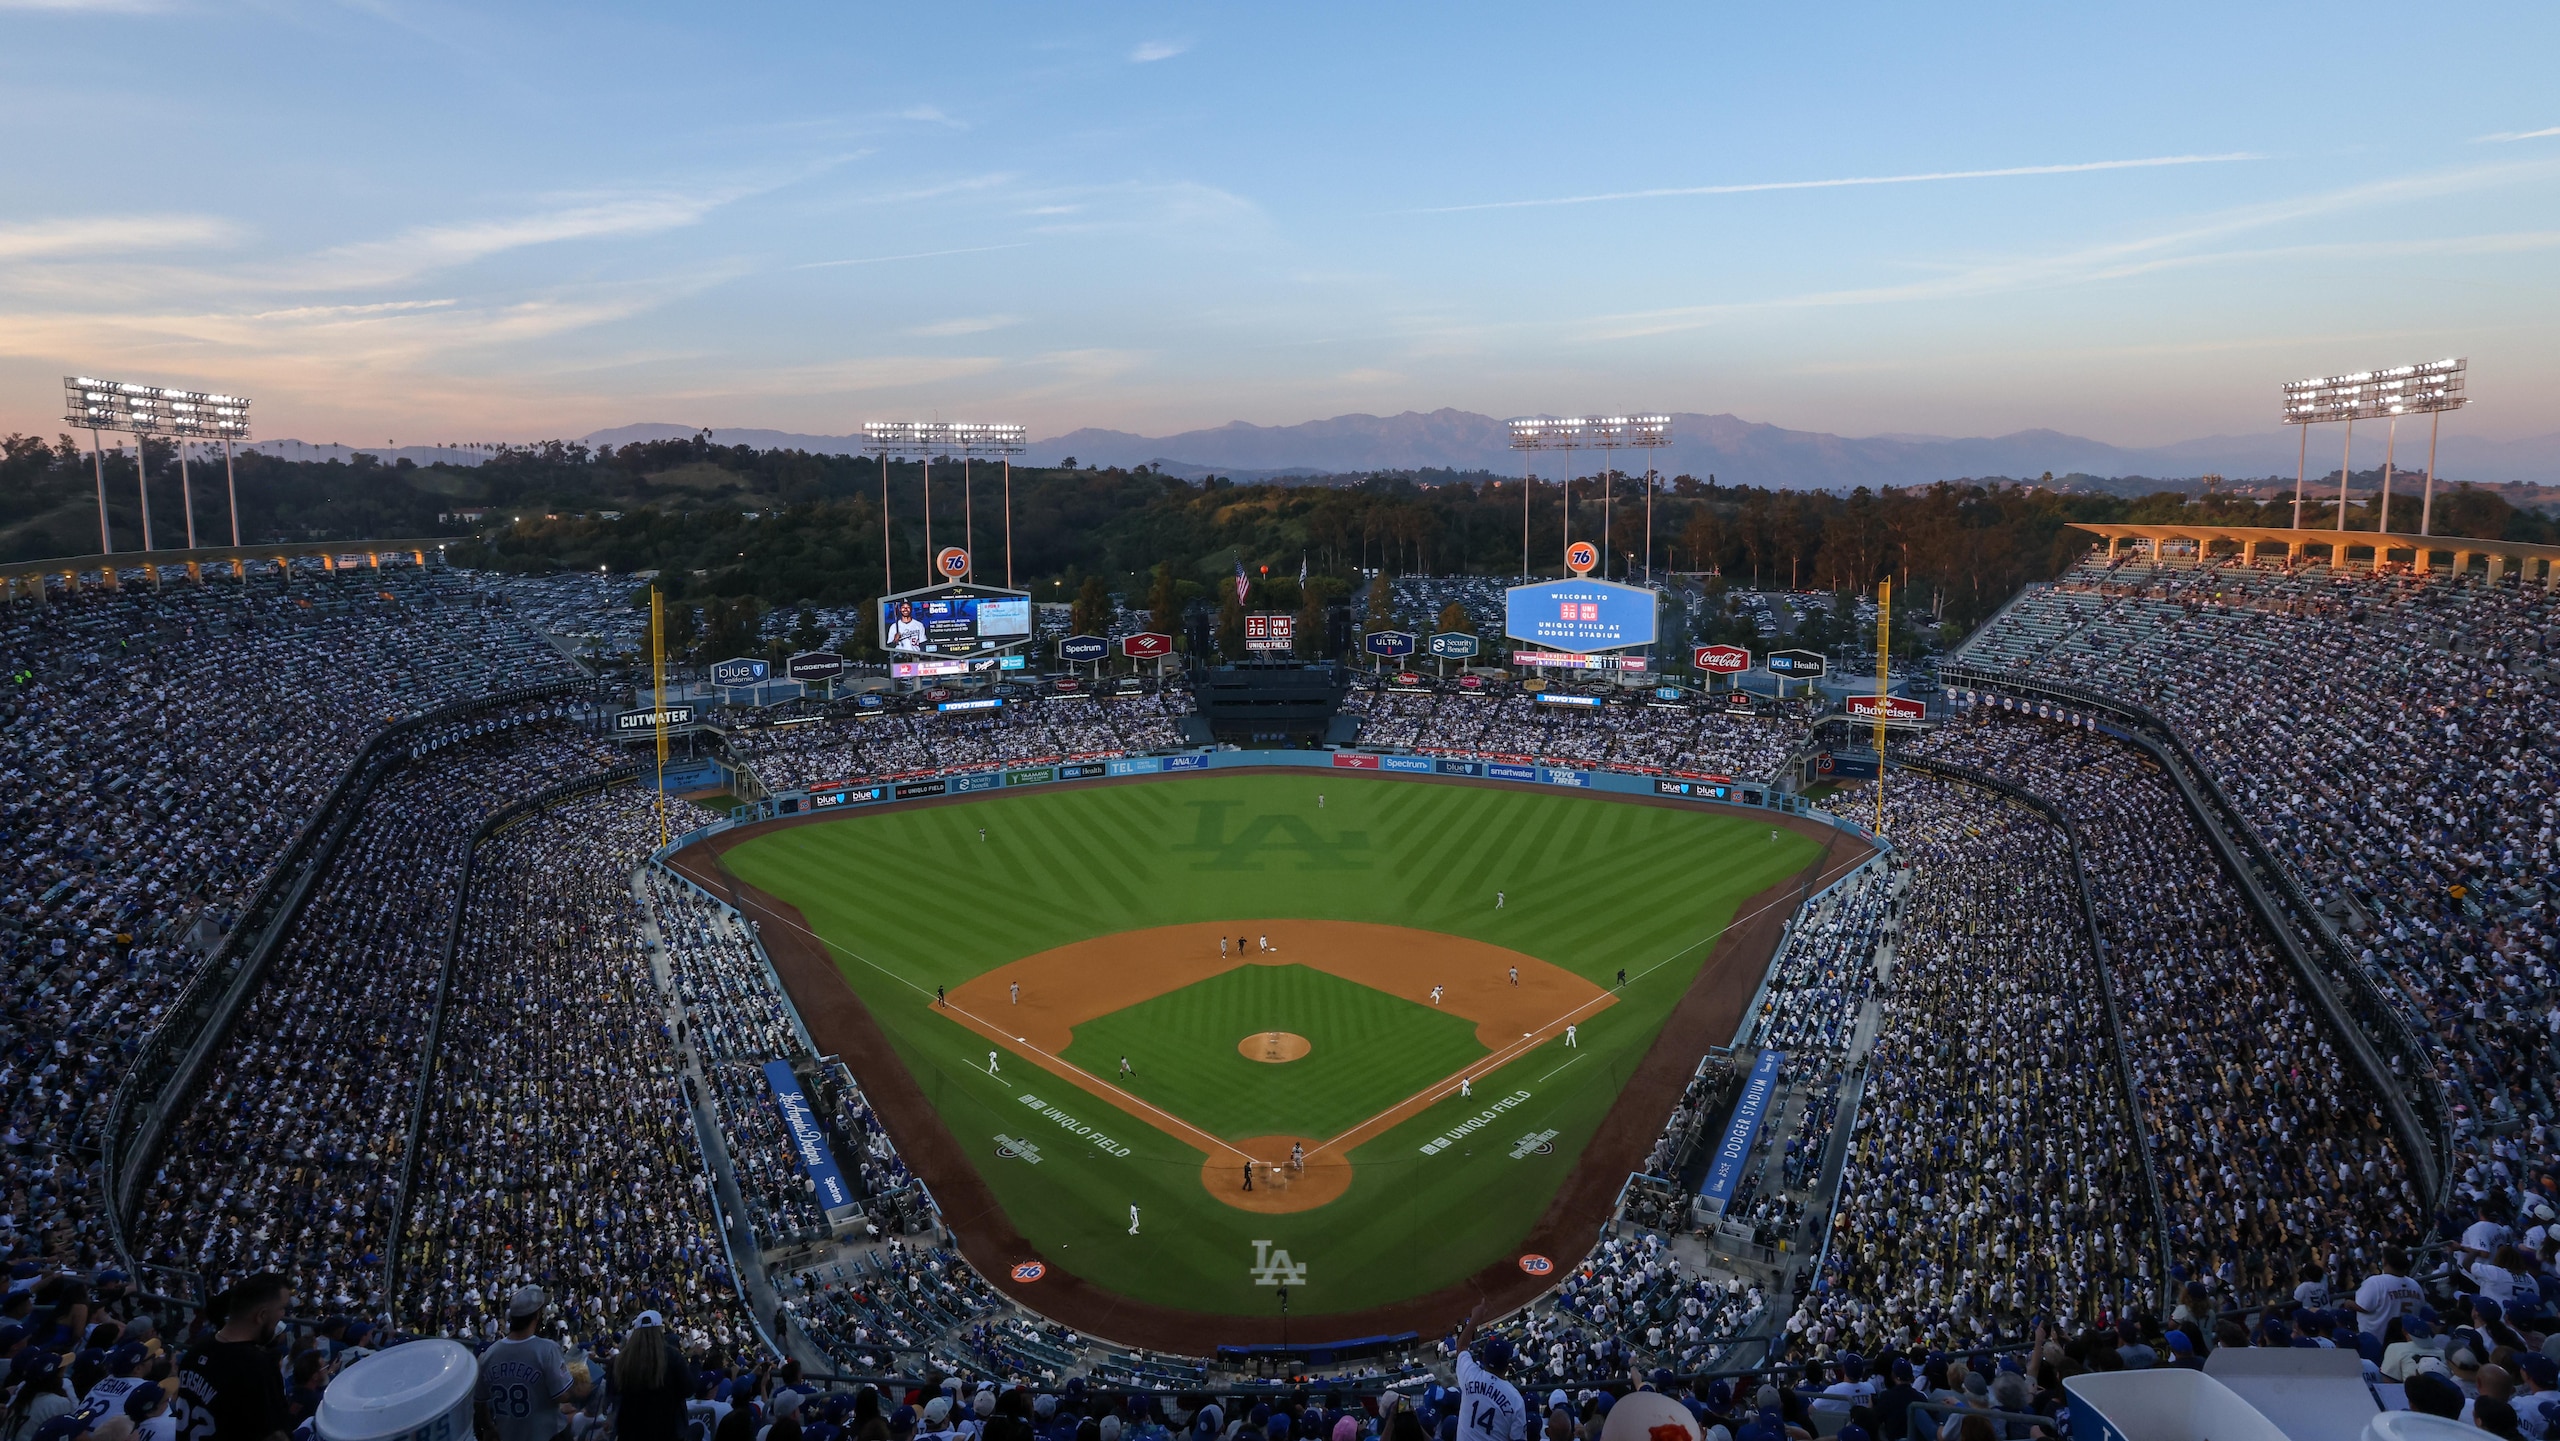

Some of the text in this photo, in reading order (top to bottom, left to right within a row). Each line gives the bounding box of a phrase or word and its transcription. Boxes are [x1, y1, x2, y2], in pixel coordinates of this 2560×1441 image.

[946, 554, 965, 570] 76
[1572, 551, 1591, 564] 76
[1273, 627, 1289, 636] QLO
[1579, 631, 1621, 639] STADIUM
[1249, 641, 1270, 649] UNIQLO
[1376, 638, 1403, 646] ULTRA
[1447, 639, 1473, 648] Security
[1065, 644, 1101, 654] Spectrum
[1447, 646, 1470, 654] Benefit
[1700, 651, 1743, 667] Coca-Cola
[794, 662, 839, 671] GUGGENHEIM
[975, 659, 995, 671] Dodgers
[1794, 660, 1820, 670] Health
[718, 665, 750, 678] blue
[724, 676, 754, 684] california
[1659, 689, 1677, 698] TEL
[945, 700, 996, 710] TOYO TIRES
[1568, 696, 1594, 704] TIRES
[1853, 703, 1917, 719] Budweiser
[620, 710, 688, 728] CUTWATER
[1172, 756, 1190, 766] ANA
[1386, 758, 1425, 770] Spectrum
[1818, 757, 1833, 769] 76
[1082, 765, 1102, 774] Health
[1111, 763, 1134, 773] TEL
[1446, 763, 1465, 772] blue
[1490, 768, 1533, 778] smartwater
[1548, 770, 1575, 778] TOYO
[971, 776, 991, 784] Security
[1553, 777, 1582, 786] TIRES
[908, 784, 945, 794] UNIQLO FIELD
[1661, 782, 1680, 791] blue
[1696, 785, 1716, 795] blue
[816, 795, 836, 804] blue
[852, 791, 871, 799] blue
[1170, 800, 1374, 872] LA
[1446, 1090, 1532, 1140] UNIQLO FIELD
[1724, 1118, 1752, 1159] DODGER
[1741, 1078, 1768, 1116] STADIUM
[1042, 1107, 1131, 1158] UNIQLO FIELD
[798, 1131, 824, 1166] Dodgers
[824, 1175, 843, 1204] Spectrum
[1250, 1240, 1306, 1285] LA
[1524, 1257, 1550, 1272] 76
[1014, 1266, 1042, 1279] 76
[2310, 1294, 2329, 1308] 50
[485, 1361, 543, 1385] UERRERO
[490, 1383, 531, 1418] 28
[1464, 1381, 1514, 1417] HERNÁNDEZ
[1470, 1400, 1496, 1436] 14
